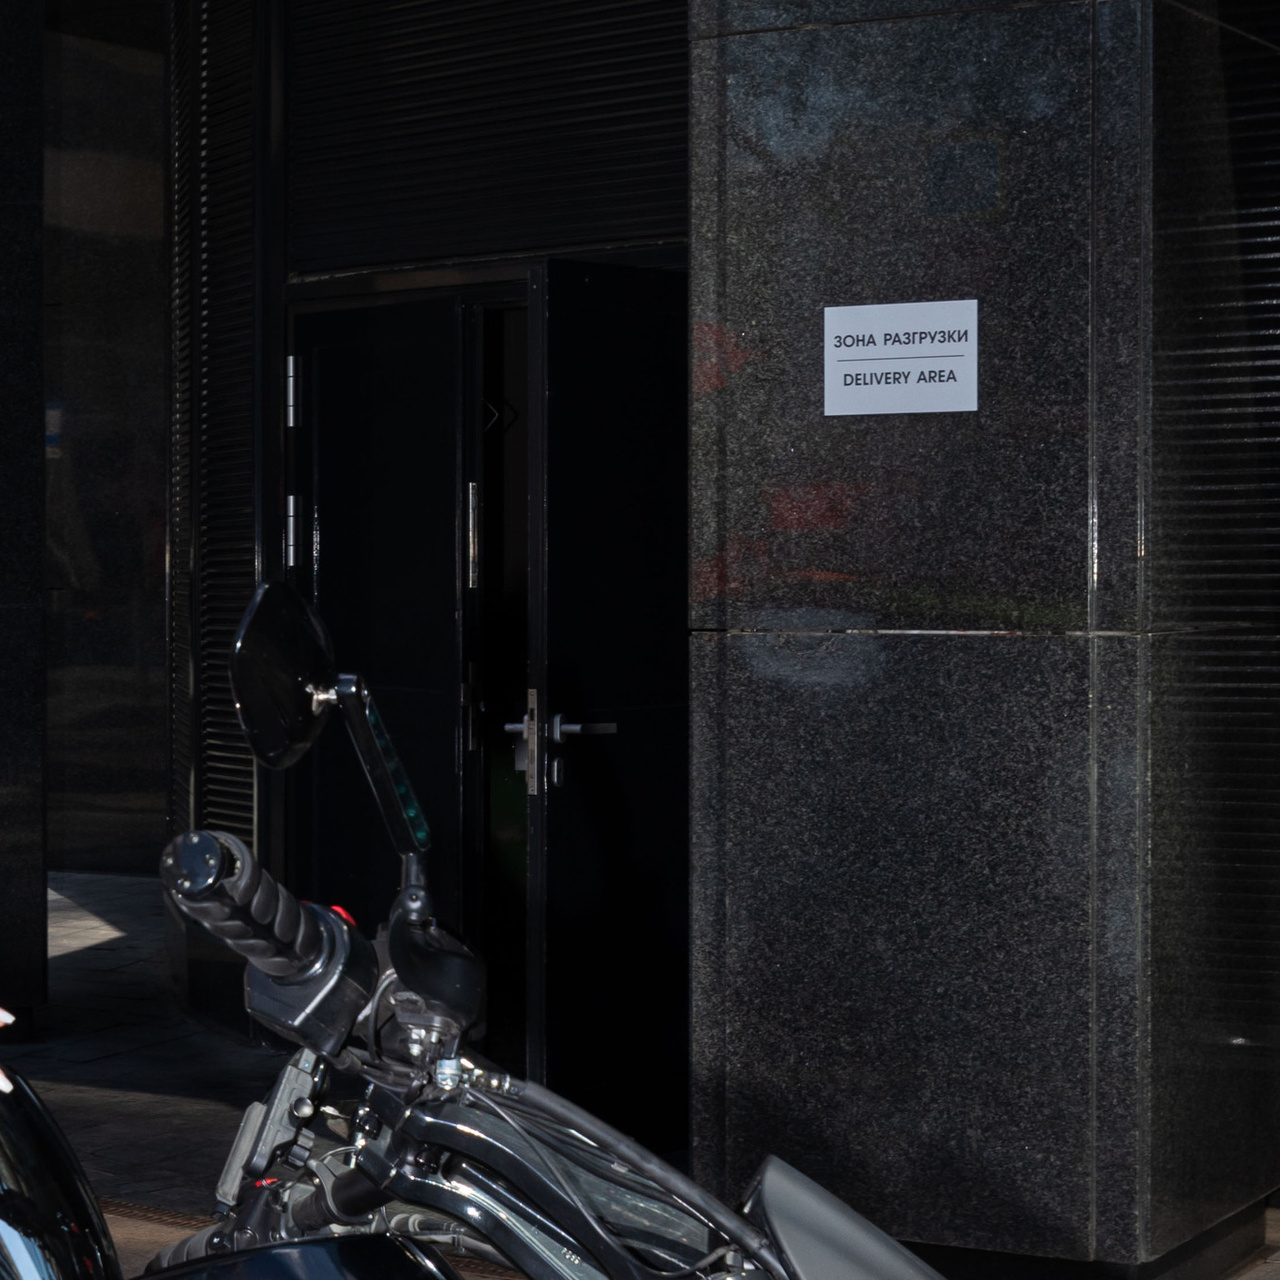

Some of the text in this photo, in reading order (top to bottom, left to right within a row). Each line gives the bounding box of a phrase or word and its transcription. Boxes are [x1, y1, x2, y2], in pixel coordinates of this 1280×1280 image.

[834, 329, 969, 348] ЗОНА РАЗГРУЗКИ
[843, 369, 957, 386] DELIVERY AREA
